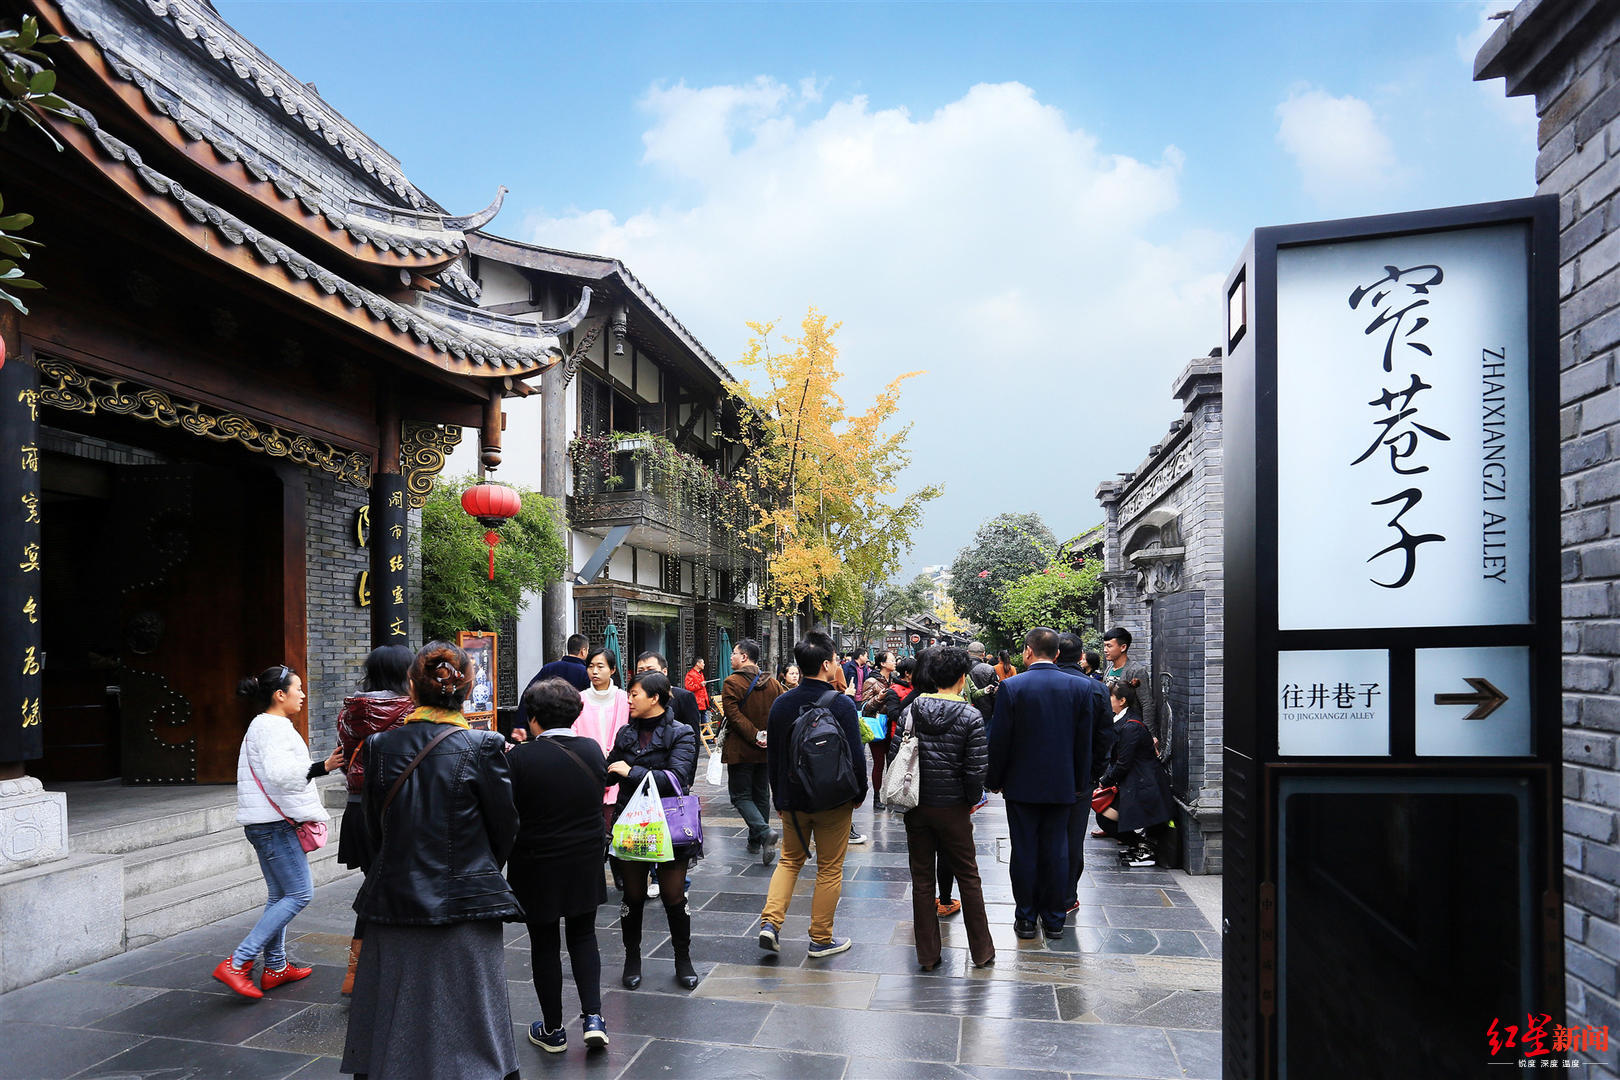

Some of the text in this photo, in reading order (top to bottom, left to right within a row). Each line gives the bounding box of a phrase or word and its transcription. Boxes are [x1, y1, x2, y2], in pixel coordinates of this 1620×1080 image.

[1349, 265, 1451, 589] 窄巷子
[1482, 346, 1507, 585] ZHAIXIANGZI ALLEY
[1282, 682, 1382, 710] 往井巷子
[1296, 712, 1348, 722] JINGXIANGZI
[1350, 712, 1375, 720] ALLEY
